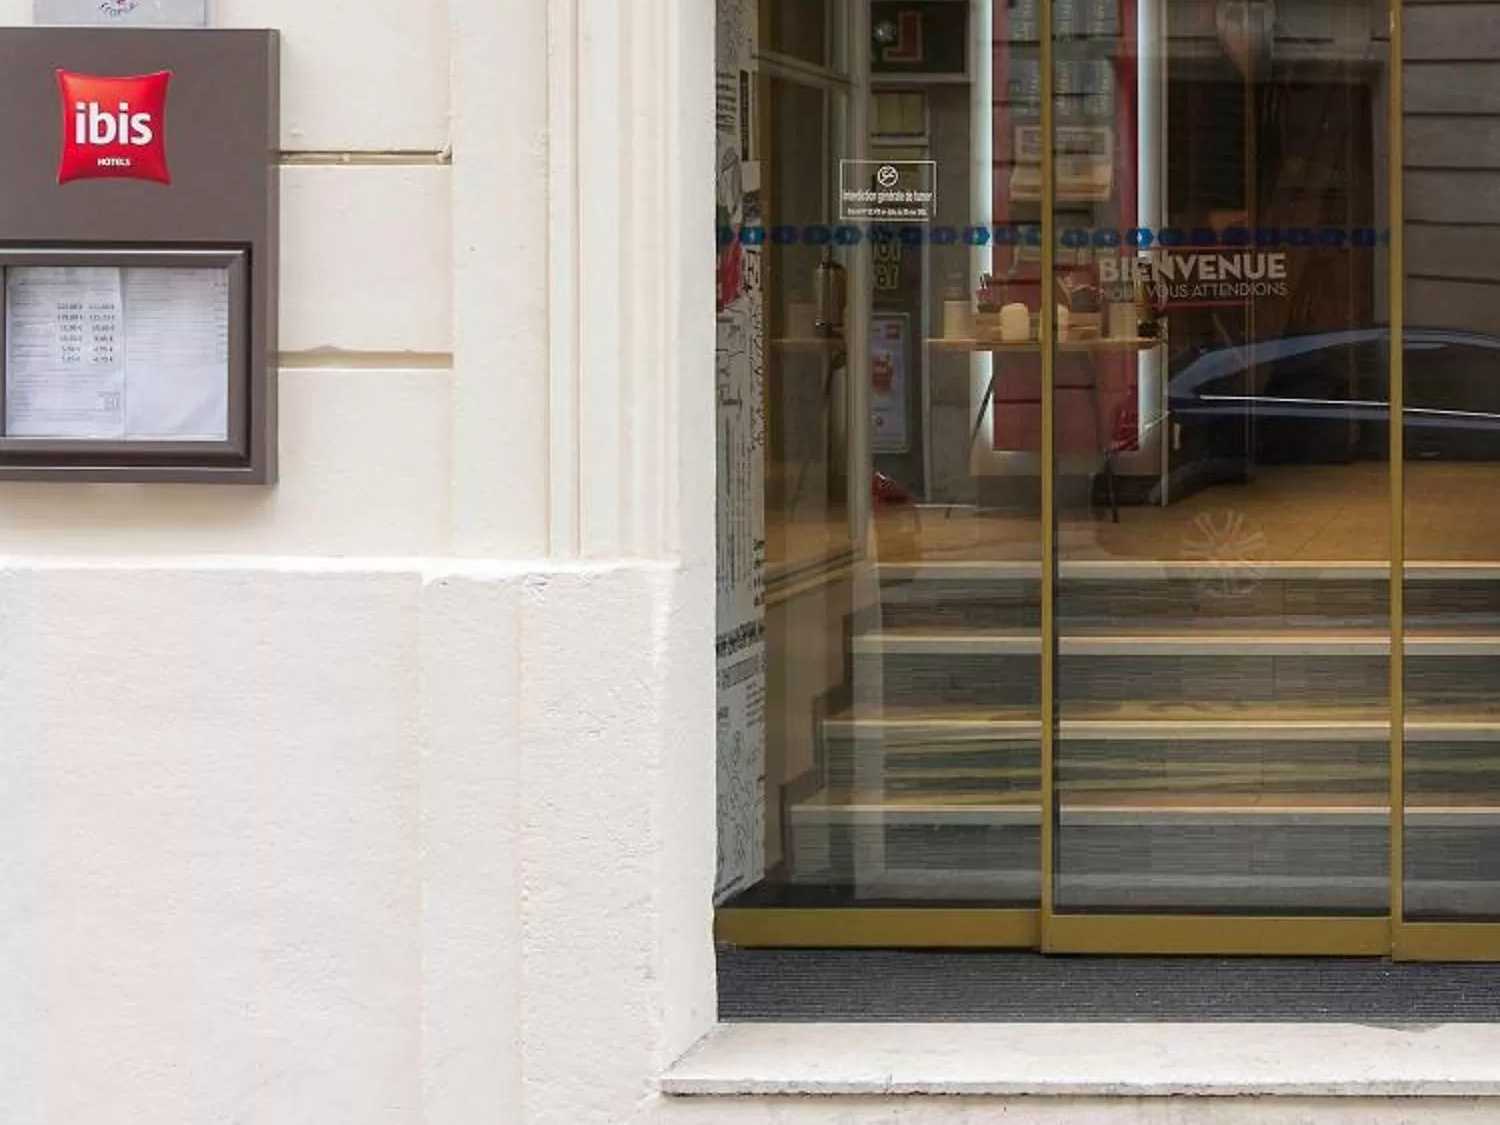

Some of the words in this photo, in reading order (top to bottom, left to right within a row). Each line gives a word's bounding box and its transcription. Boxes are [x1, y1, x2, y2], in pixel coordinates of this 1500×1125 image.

[75, 101, 153, 145] ibis
[97, 158, 131, 166] HOTELS
[1099, 252, 1287, 282] BIENVENUE
[1146, 284, 1188, 299] VOUS
[1191, 282, 1287, 299] ATTENDIONS
